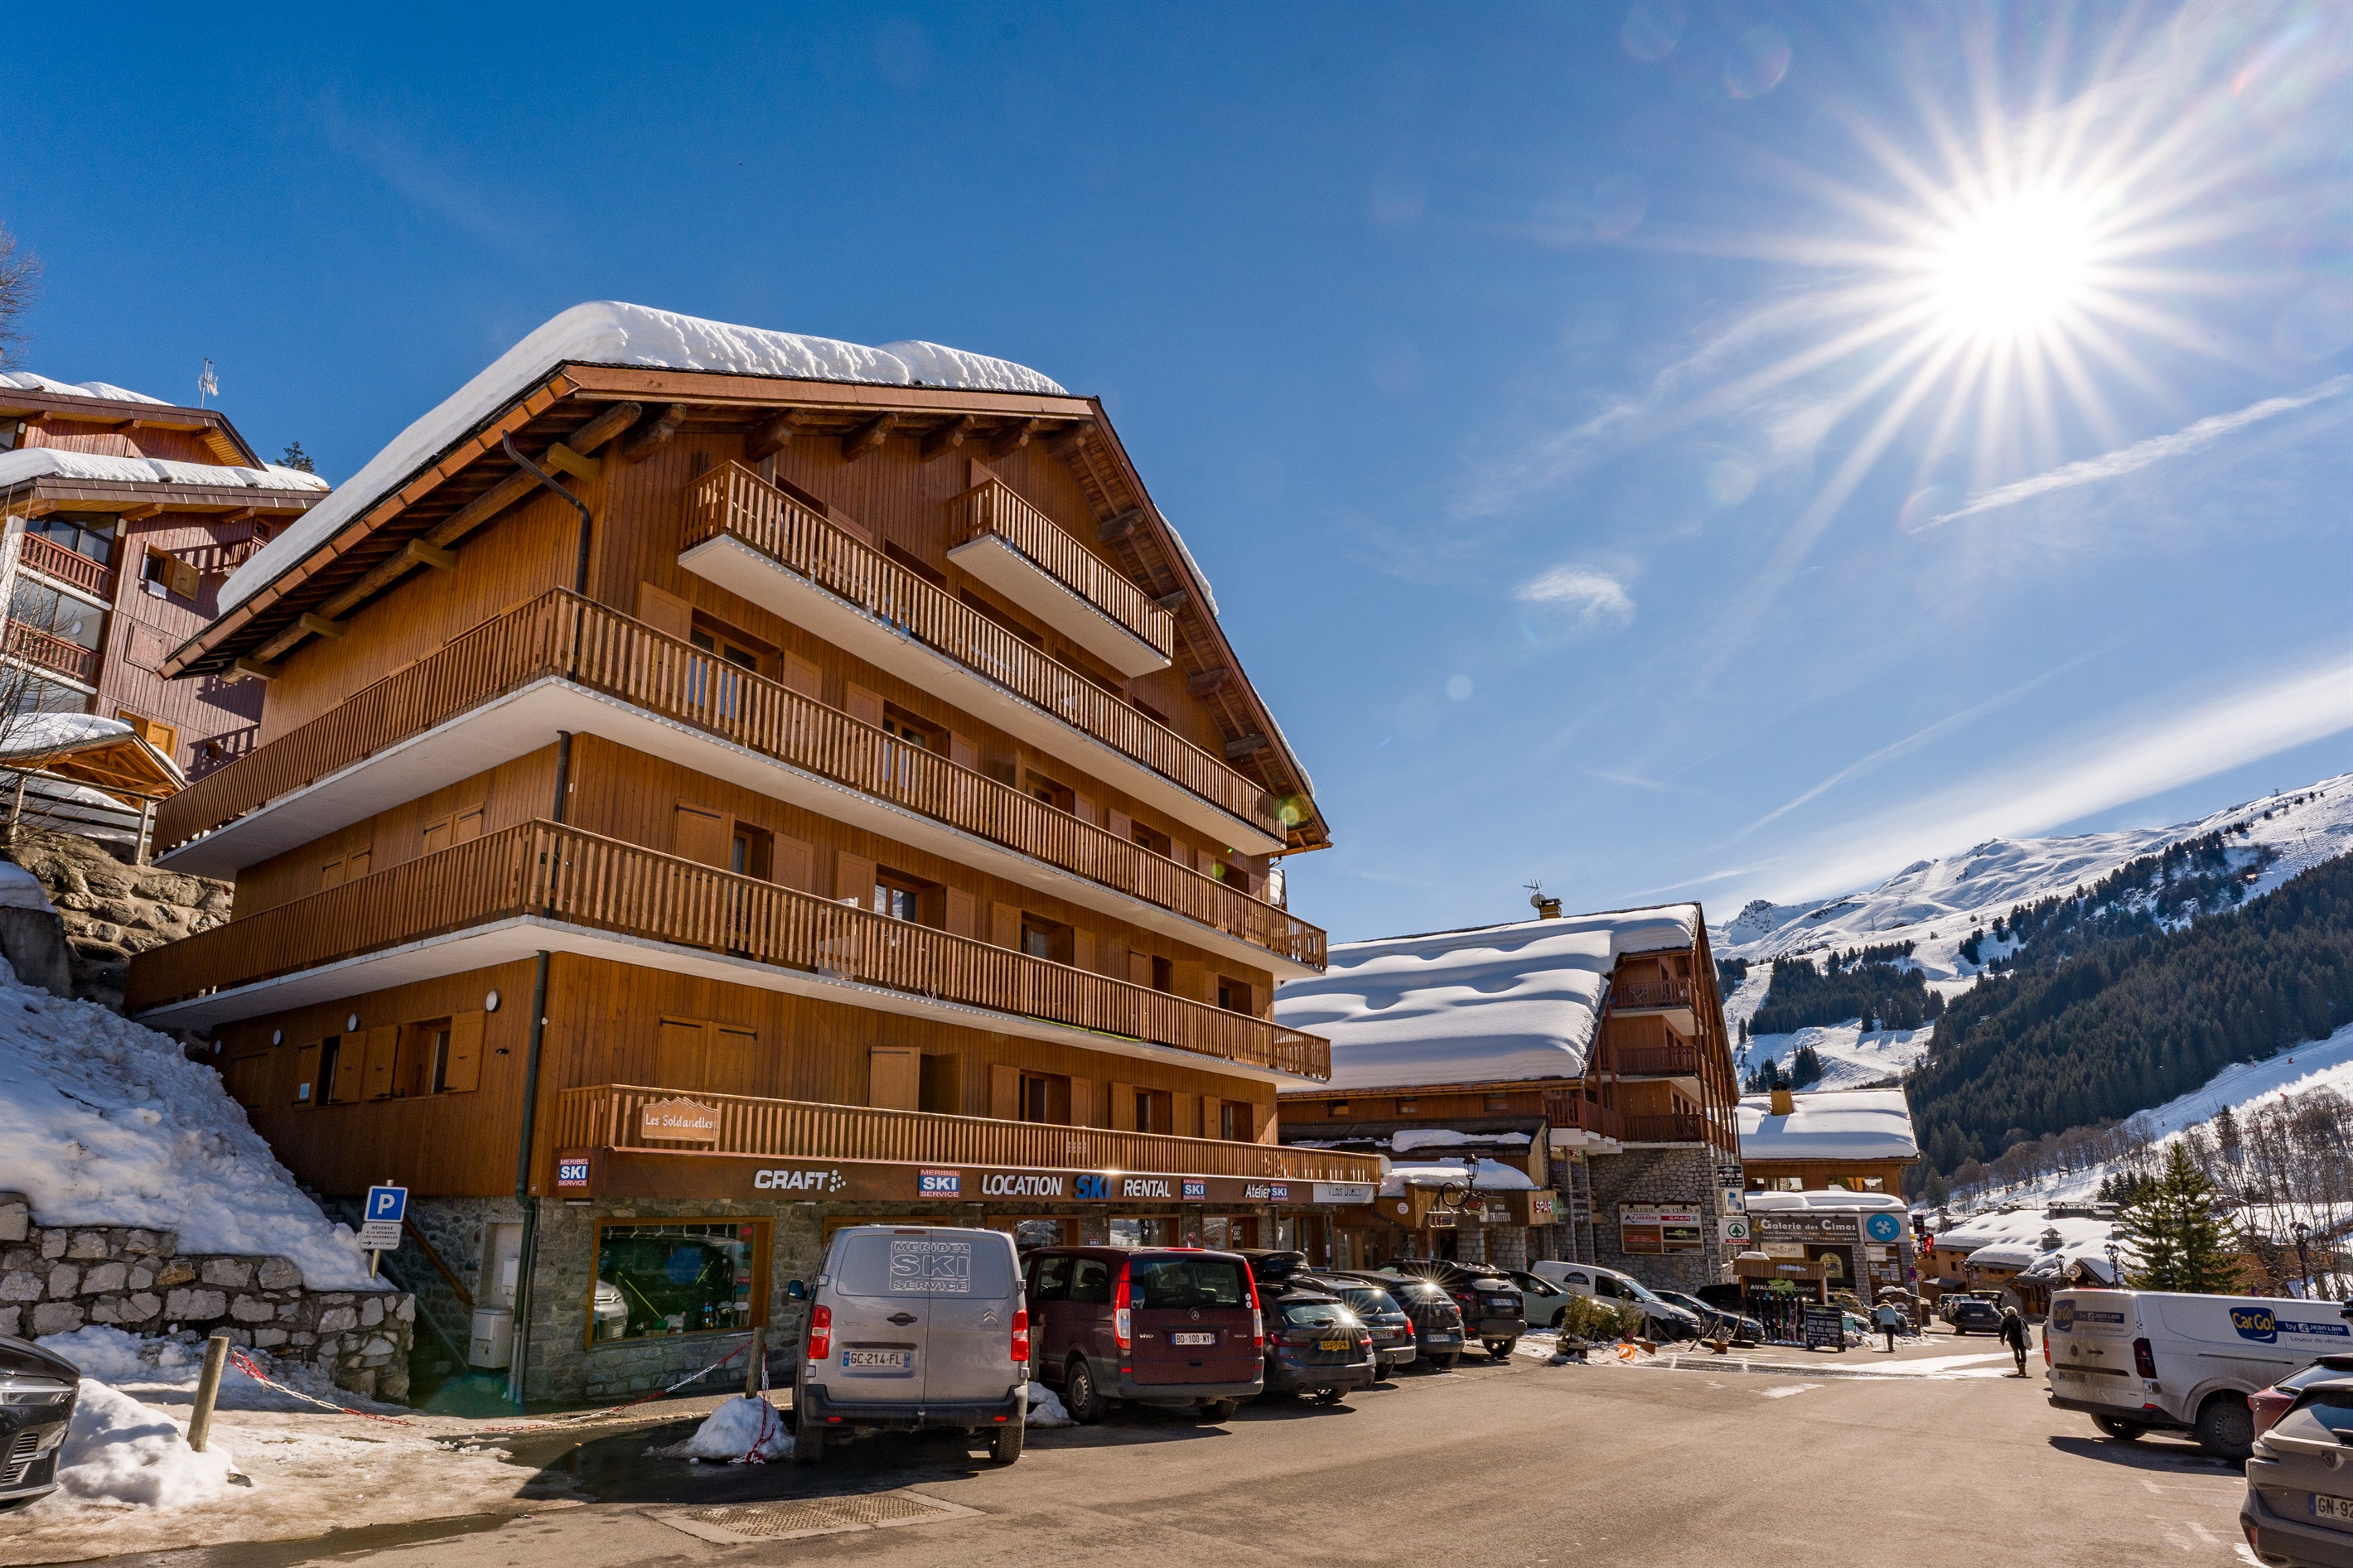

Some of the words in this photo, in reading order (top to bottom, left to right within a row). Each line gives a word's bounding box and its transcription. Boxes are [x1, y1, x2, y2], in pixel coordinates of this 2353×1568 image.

[645, 1113, 660, 1126] Les
[663, 1114, 713, 1129] Soldanelles
[560, 1165, 587, 1179] SKI
[754, 1170, 828, 1190] CRAFT
[922, 1176, 957, 1190] SKI
[982, 1174, 1063, 1196] LOCATION
[1075, 1175, 1111, 1199] SKI
[1123, 1179, 1171, 1198] RENTAL
[1185, 1184, 1205, 1195] SKI
[1245, 1184, 1270, 1199] Atelier
[1272, 1187, 1288, 1197] SKI
[1327, 1184, 1342, 1196] Vins
[377, 1194, 395, 1214] P
[1535, 1200, 1552, 1213] SPAR
[1761, 1218, 1801, 1230] Galerie
[1821, 1219, 1856, 1230] Cimes
[895, 1242, 969, 1252] MERIBEL
[891, 1253, 969, 1277] SKI
[893, 1280, 968, 1291] SERVICE
[2285, 1323, 2296, 1331] by
[1176, 1334, 1210, 1344] BD-100-MY
[2324, 1338, 2353, 1346] véhicules
[850, 1353, 902, 1365] GC-214-FL
